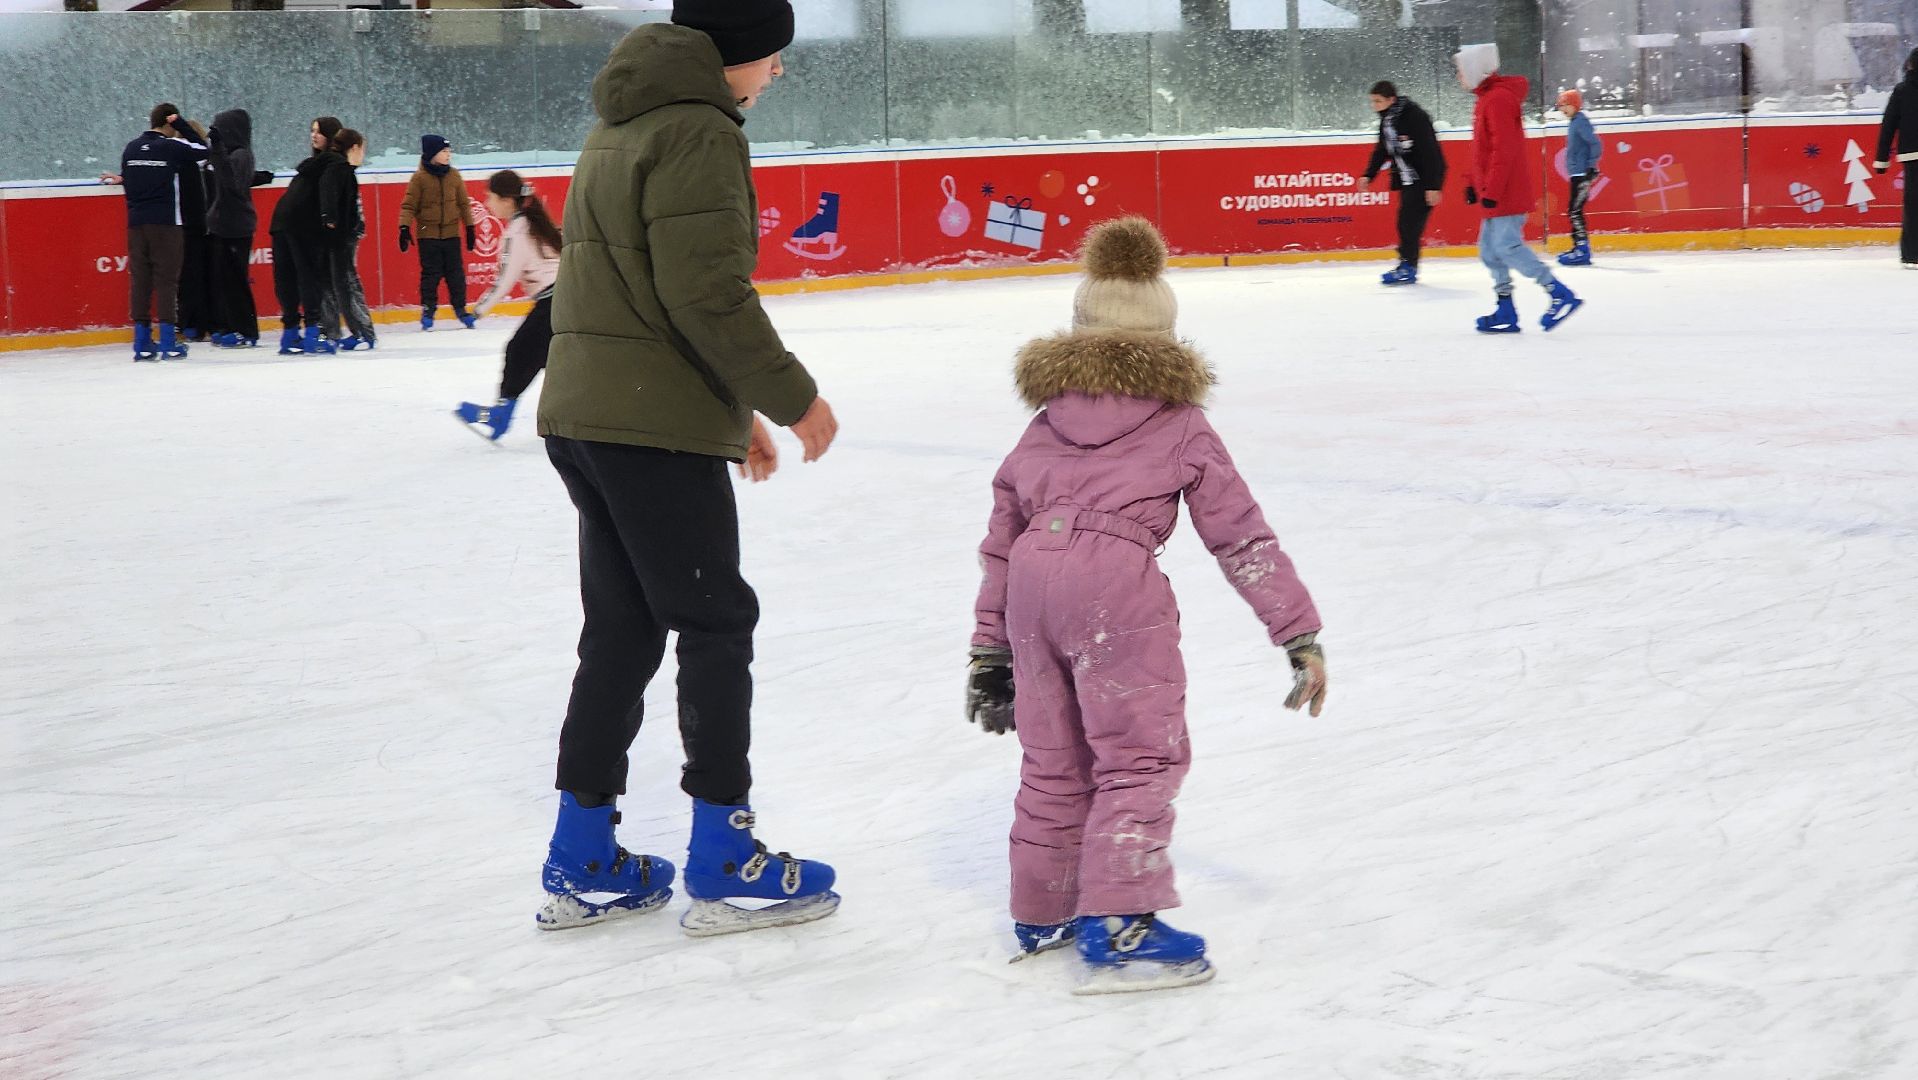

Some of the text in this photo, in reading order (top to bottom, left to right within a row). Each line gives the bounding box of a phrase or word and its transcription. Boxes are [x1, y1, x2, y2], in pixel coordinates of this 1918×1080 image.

[1254, 170, 1355, 188] КАТАЙТЕСЬ
[1220, 191, 1390, 212] С УДОВОЛЬСТВИЕМ!
